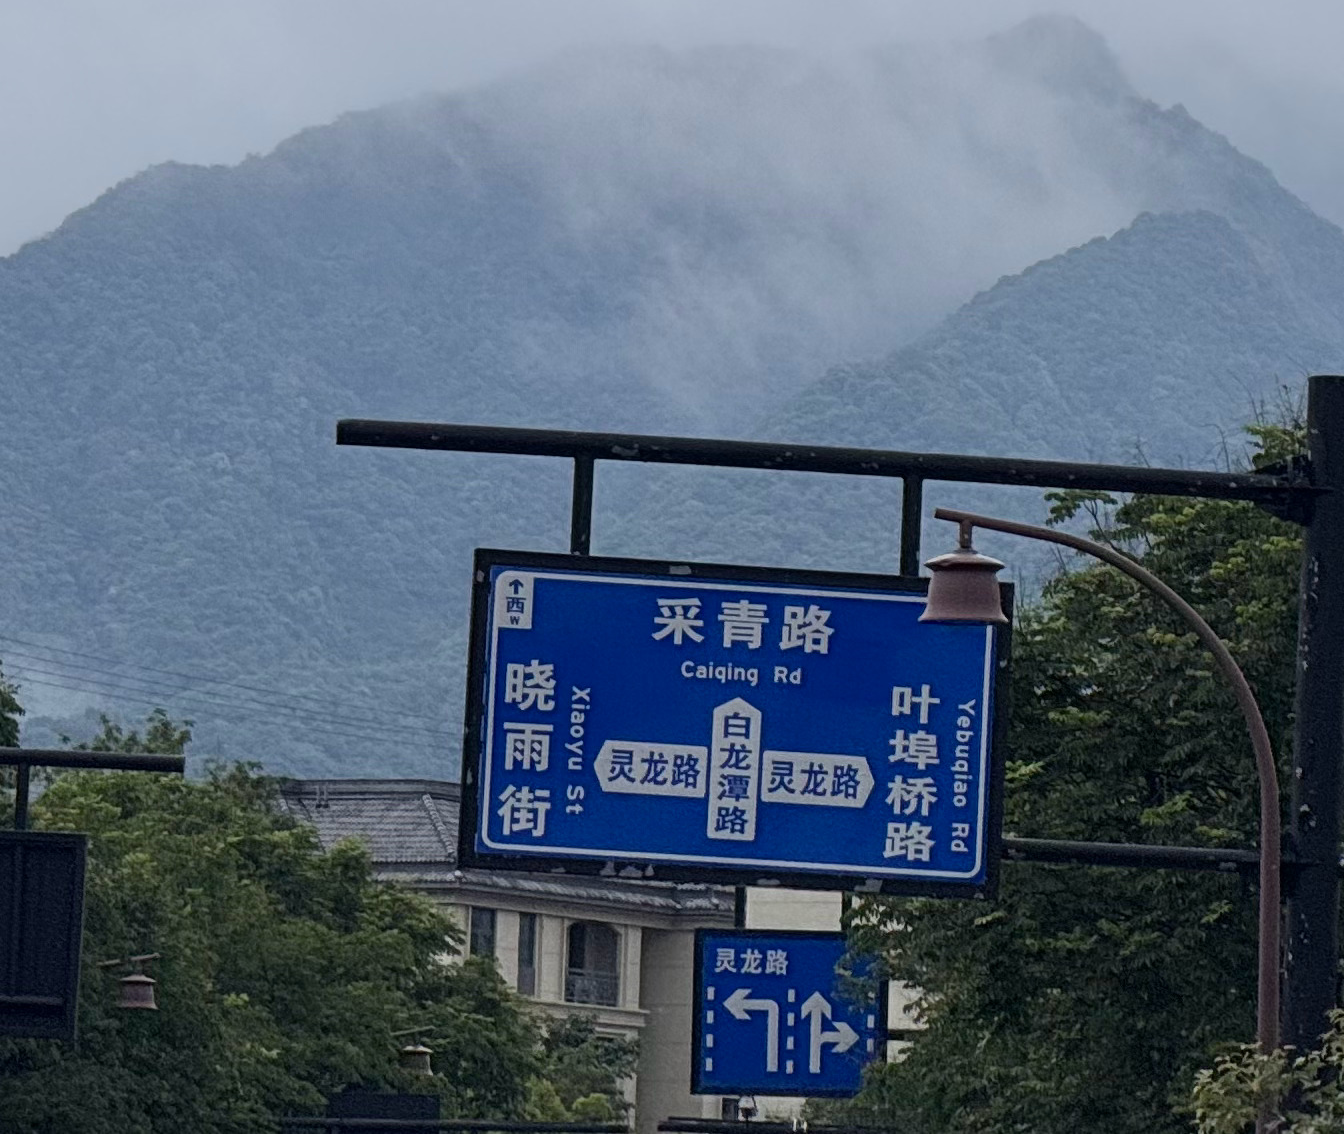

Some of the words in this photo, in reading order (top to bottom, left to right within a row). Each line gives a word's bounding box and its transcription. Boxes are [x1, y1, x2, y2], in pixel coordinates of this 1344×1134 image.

[506, 596, 527, 614] 西
[509, 615, 521, 626] W
[651, 597, 835, 655] 采青路
[680, 660, 760, 688] Caiqing
[773, 664, 802, 686] Rd
[497, 659, 556, 837] 晓雨街
[564, 685, 591, 771] Xiaoyu
[607, 748, 701, 789] 灵龙路
[714, 712, 752, 834] 白龙潭路
[882, 683, 941, 863] 叶埠桥路
[951, 698, 976, 808] Yebuqiao
[565, 784, 585, 815] St
[767, 760, 861, 800] 灵龙路
[950, 822, 970, 853] Rd
[714, 947, 789, 976] 灵龙路
